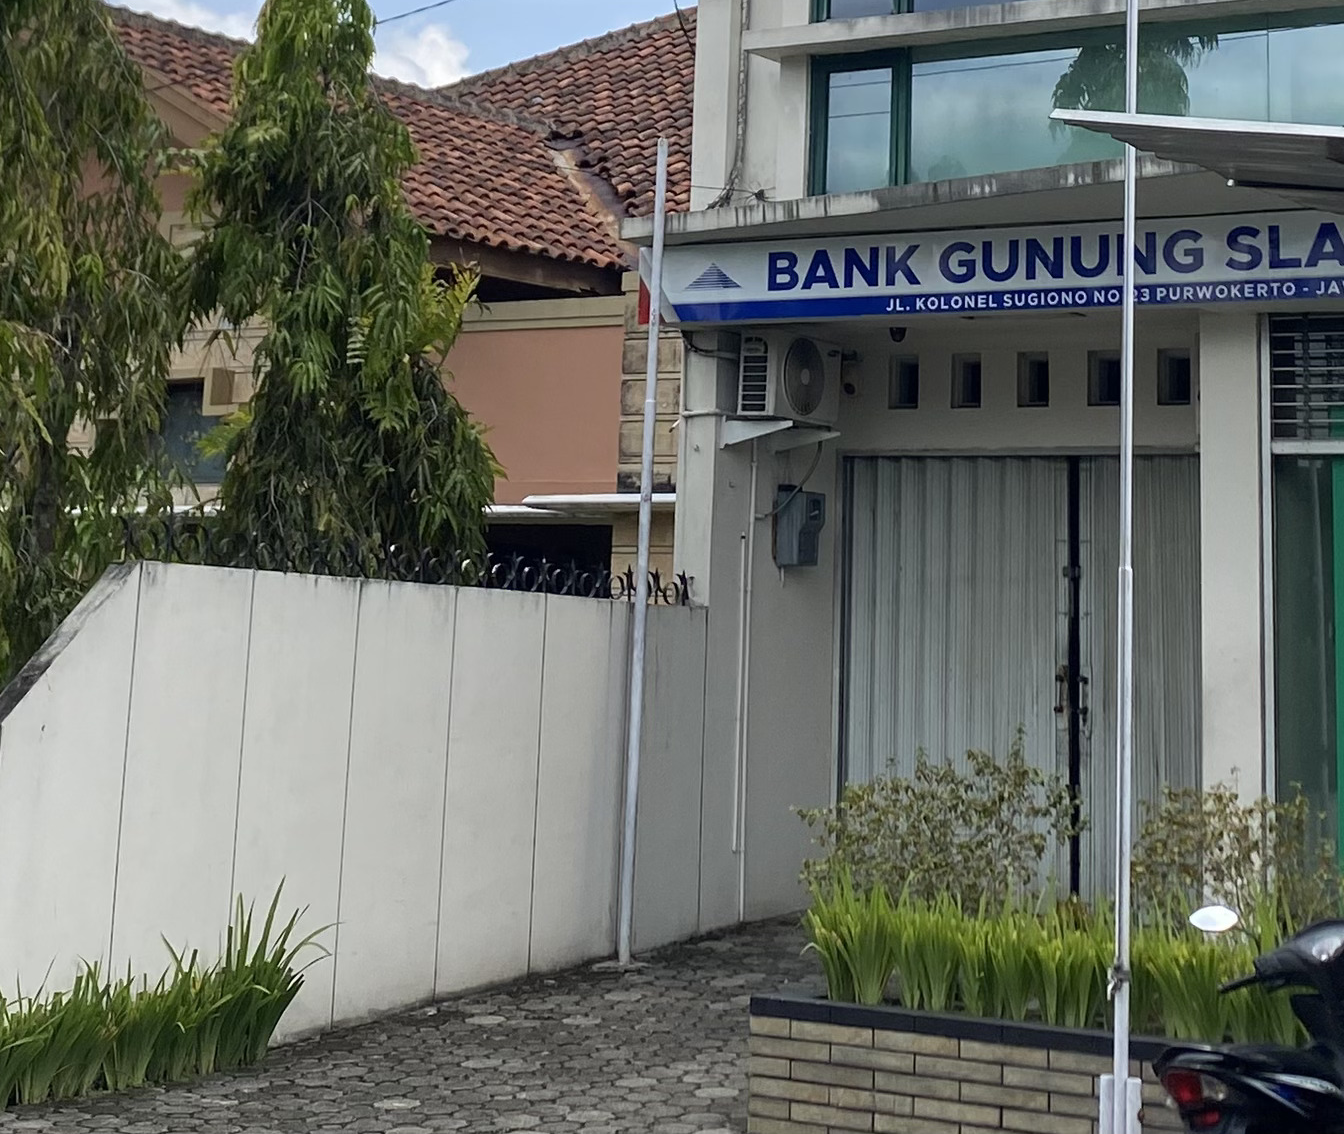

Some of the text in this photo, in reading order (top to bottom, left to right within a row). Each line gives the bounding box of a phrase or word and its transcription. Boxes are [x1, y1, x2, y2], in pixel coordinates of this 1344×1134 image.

[767, 244, 922, 293] BANK
[938, 229, 1204, 284] GUNUNG
[885, 297, 910, 312] JL.
[915, 293, 997, 311] KOLONEL
[1002, 289, 1087, 308] SUGIONO
[1156, 281, 1296, 302] PURWOKERTO
